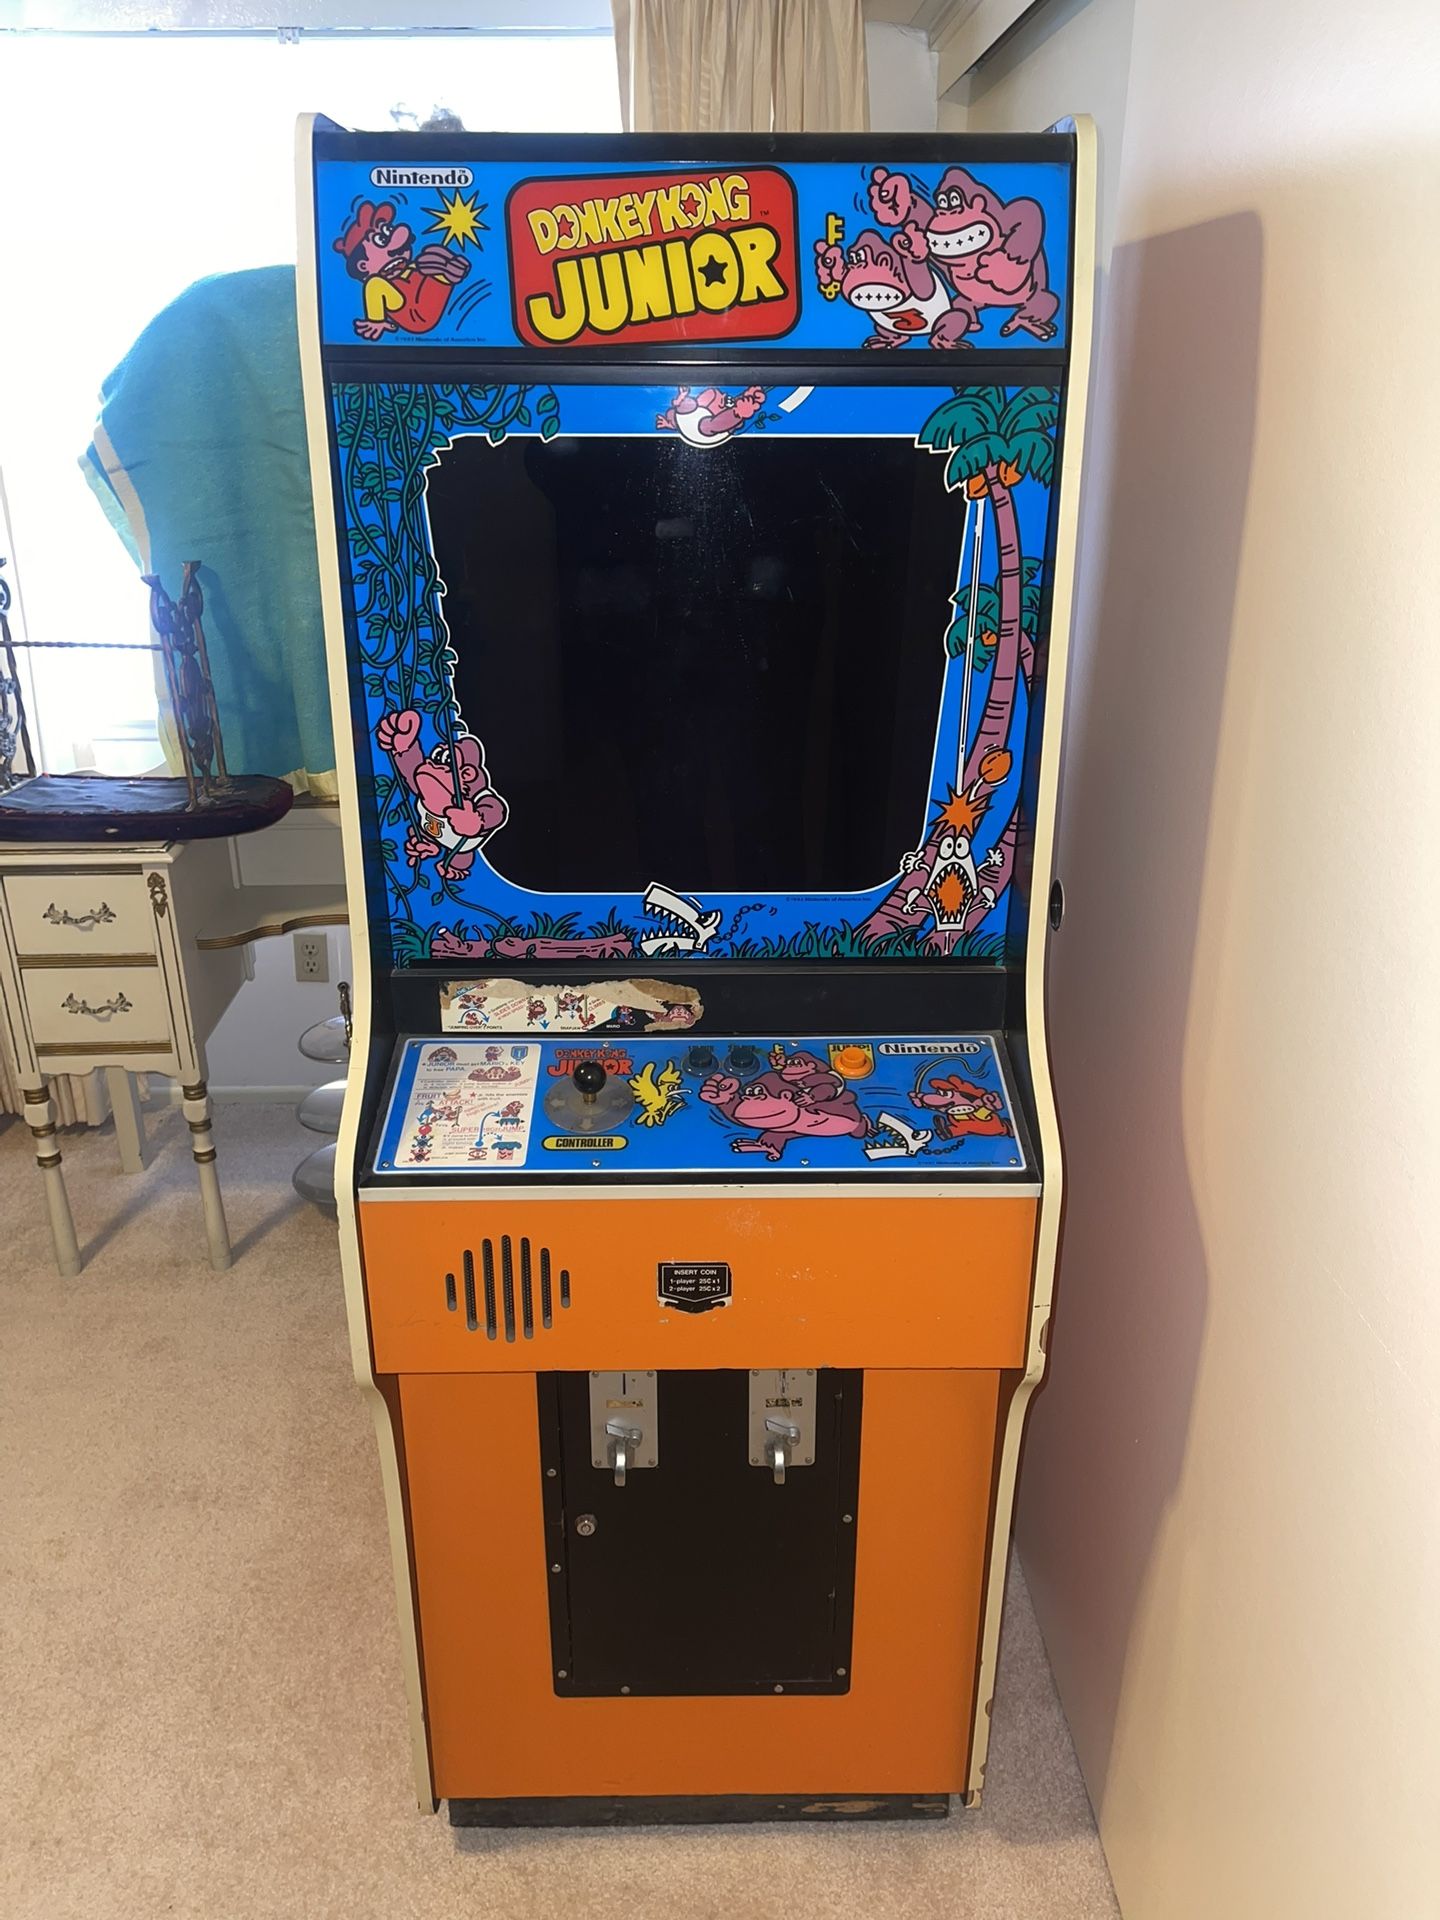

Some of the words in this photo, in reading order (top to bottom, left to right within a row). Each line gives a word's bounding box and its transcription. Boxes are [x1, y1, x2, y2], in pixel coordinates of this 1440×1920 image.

[376, 169, 469, 185] Nintendo
[527, 193, 656, 255] DONKEY
[655, 174, 751, 229] KONG
[526, 222, 787, 345] JUNIOR
[885, 1044, 978, 1054] Nintendo
[555, 1138, 614, 1148] CONTROLLER
